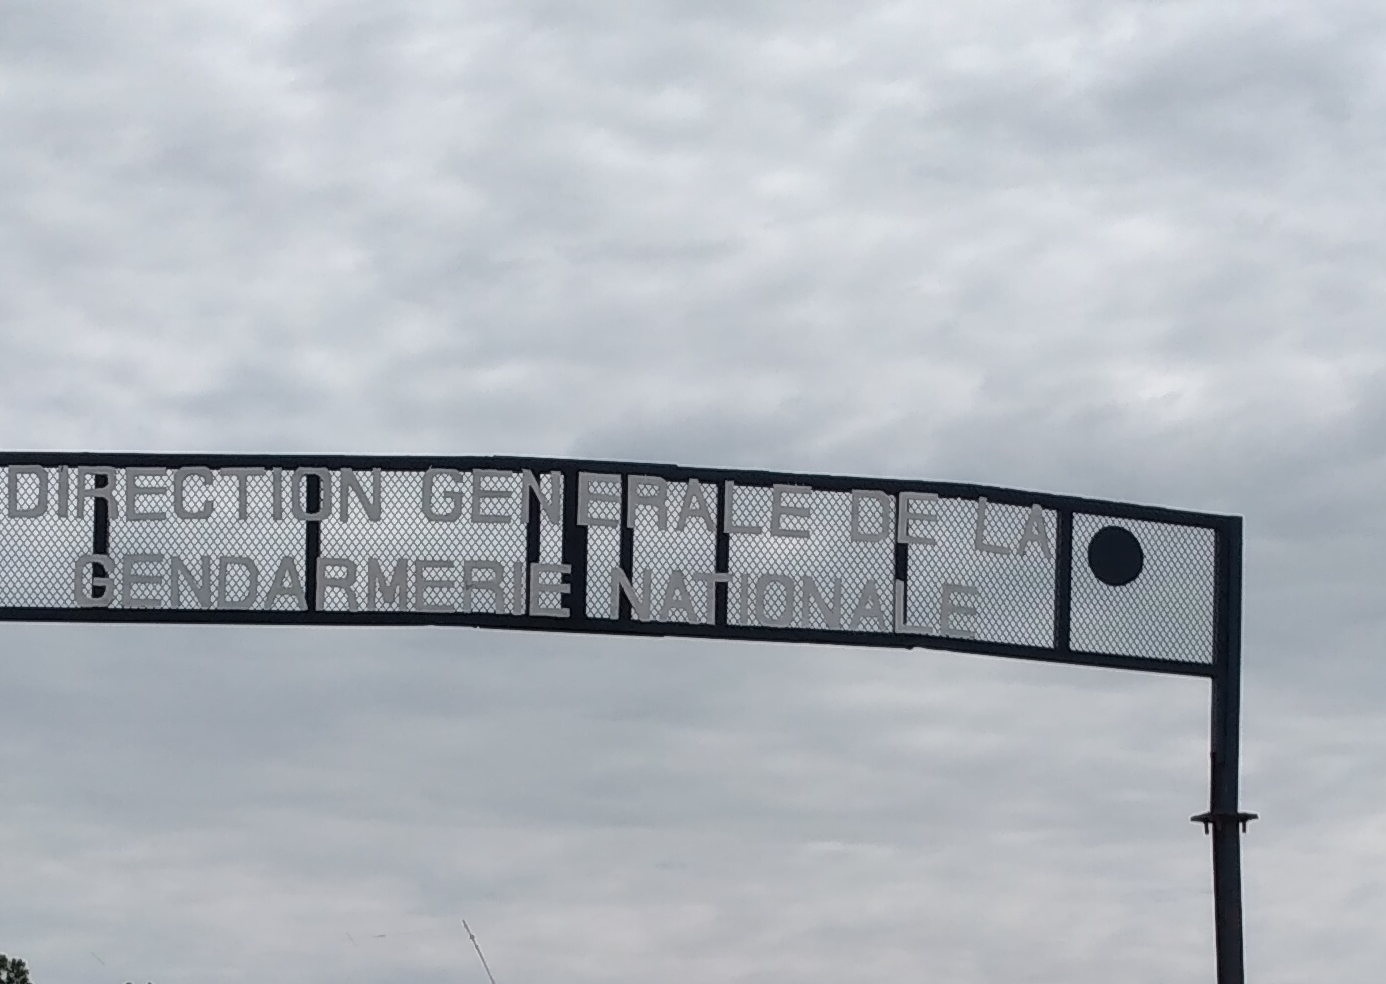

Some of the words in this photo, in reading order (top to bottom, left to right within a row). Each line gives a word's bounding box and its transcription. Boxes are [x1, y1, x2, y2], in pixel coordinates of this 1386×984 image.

[7, 463, 382, 523] DIRECTION
[419, 467, 813, 538] GENERALE
[851, 488, 939, 546] DE
[974, 496, 1052, 559] LA
[73, 552, 573, 618] GENDARMERIE
[610, 564, 981, 639] NATIONALE
